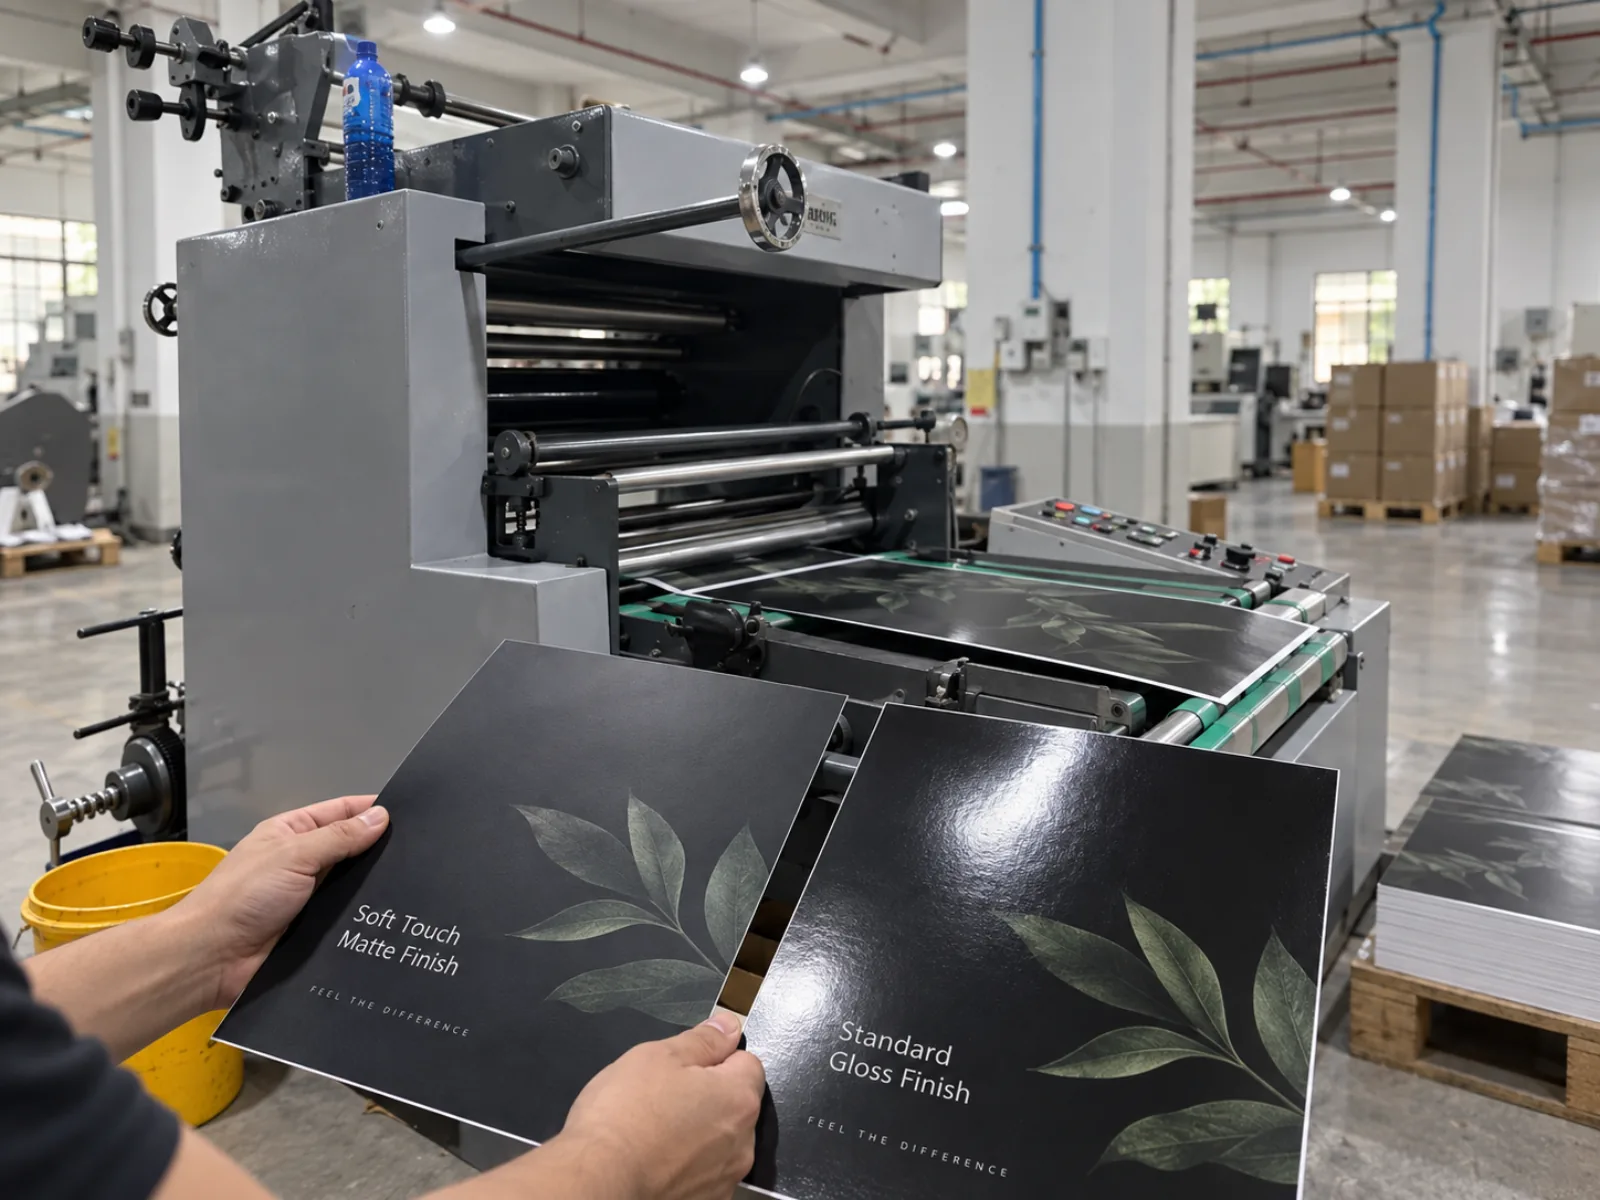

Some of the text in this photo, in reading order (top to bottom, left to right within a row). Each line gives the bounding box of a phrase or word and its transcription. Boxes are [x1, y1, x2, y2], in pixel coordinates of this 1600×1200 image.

[353, 904, 461, 946] Soft Touch
[337, 930, 459, 976] Matte Finish
[309, 985, 470, 1037] FEEL THE DIFFERENCE
[839, 1021, 953, 1066] Standard
[829, 1051, 970, 1104] Gloss Finish
[807, 1116, 1008, 1178] FEEL THE DIFFERENCE
